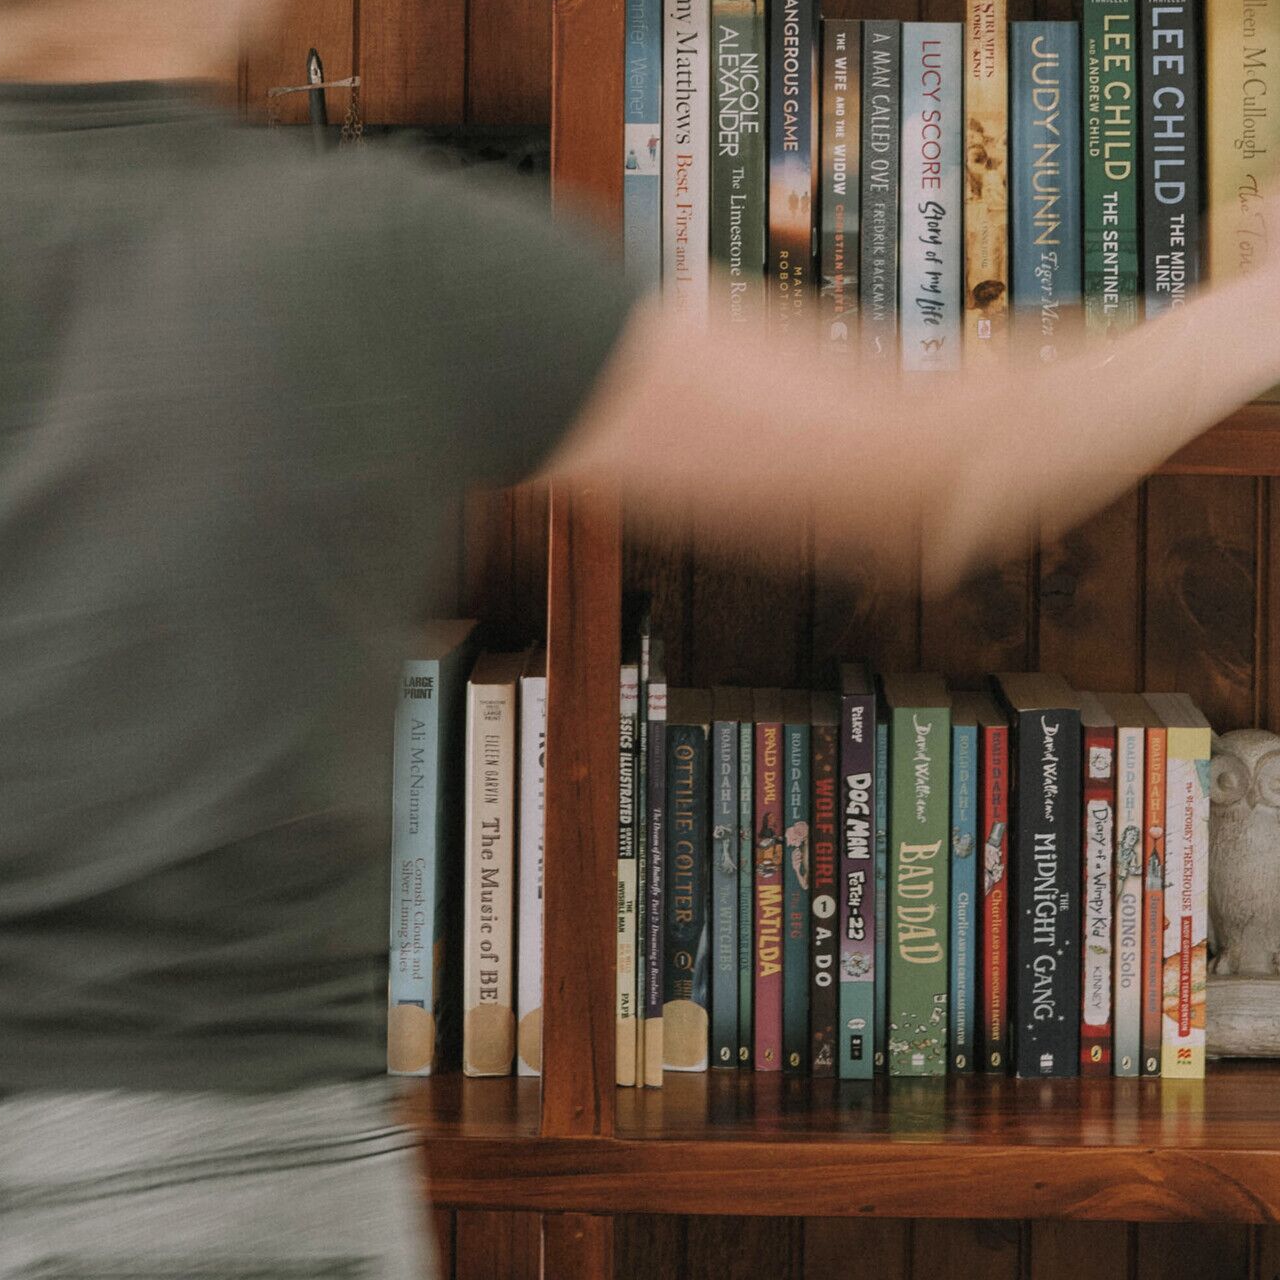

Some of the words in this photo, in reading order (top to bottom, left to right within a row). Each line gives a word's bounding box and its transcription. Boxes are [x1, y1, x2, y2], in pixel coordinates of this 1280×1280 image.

[836, 32, 846, 51] THE
[872, 33, 892, 43] A
[1103, 15, 1131, 72] LEE
[1152, 7, 1184, 76] LEE
[675, 33, 698, 145] Matthews
[718, 25, 740, 157] ALEXANDER
[834, 57, 847, 91] WIFE
[871, 51, 891, 88] MAN
[921, 41, 942, 102] LUCY
[1031, 36, 1061, 136] JUDY
[1088, 56, 1100, 113] ANDREW
[739, 53, 760, 134] NICOLE
[835, 96, 845, 117] AND
[1234, 47, 1267, 160] McCullough
[783, 100, 799, 152] GAME
[835, 120, 845, 137] THE
[870, 95, 890, 153] CALLED
[1089, 120, 1100, 157] CHILD
[1103, 81, 1132, 180] CHILD
[1152, 87, 1186, 205] CHILD
[833, 144, 846, 196] WIDOW
[921, 110, 942, 189] SCORE
[732, 167, 745, 190] The
[869, 160, 890, 192] OVE
[1032, 143, 1061, 245] NUNN
[675, 204, 693, 244] First
[872, 203, 886, 254] FREDRIK
[918, 200, 946, 245] Story
[1102, 191, 1118, 226] THE
[1170, 213, 1185, 247] THE
[729, 194, 747, 276] Limestone
[834, 203, 844, 270] CHRISTIAN
[925, 250, 943, 265] of
[675, 247, 690, 271] and
[1034, 251, 1058, 296] Tiger
[1102, 231, 1119, 314] SENTINEL
[1155, 254, 1170, 292] LINE
[834, 274, 844, 313] WHITE
[872, 259, 886, 321] BACKMAN
[920, 271, 943, 295] my
[403, 676, 434, 688] LARGE
[403, 688, 434, 699] PRINT
[410, 718, 426, 741] Ali
[484, 735, 500, 766] EILEEN
[791, 733, 801, 766] ROALD
[913, 713, 932, 761] David
[1041, 715, 1060, 762] David
[409, 747, 425, 835] McNamara
[484, 770, 500, 804] GARVIN
[619, 752, 633, 824] ILLUSTRATED
[673, 745, 694, 832] OTTILIE
[721, 763, 731, 814] DAHL
[791, 768, 801, 819] DAHL
[815, 778, 833, 834] WOLF
[846, 772, 872, 815] DOG
[914, 762, 931, 823] Walliams
[1042, 762, 1059, 823] Walliams
[480, 817, 501, 860] The
[846, 818, 871, 859] MAN
[1091, 808, 1109, 847] Diary
[400, 860, 413, 895] Silver
[815, 842, 833, 888] GIRL
[897, 839, 942, 899] BAD
[1095, 849, 1107, 861] of
[480, 867, 500, 934] Music
[617, 880, 626, 913] INVISIBLE
[673, 840, 694, 924] COLTER
[1059, 892, 1070, 912] THE
[1088, 871, 1107, 916] Wimpy
[412, 911, 425, 955] Clouds
[758, 884, 783, 977] MATILDA
[896, 904, 944, 964] DAD
[991, 889, 1002, 934] Charlie
[1091, 917, 1108, 938] Kid
[1121, 893, 1137, 947] GOING
[480, 940, 500, 963] of
[814, 954, 833, 987] DO
[1121, 949, 1136, 989] Solo
[1032, 954, 1057, 1021] GANG
[1091, 965, 1103, 1010] KINNEY
[991, 1009, 1001, 1041] FACTORY
